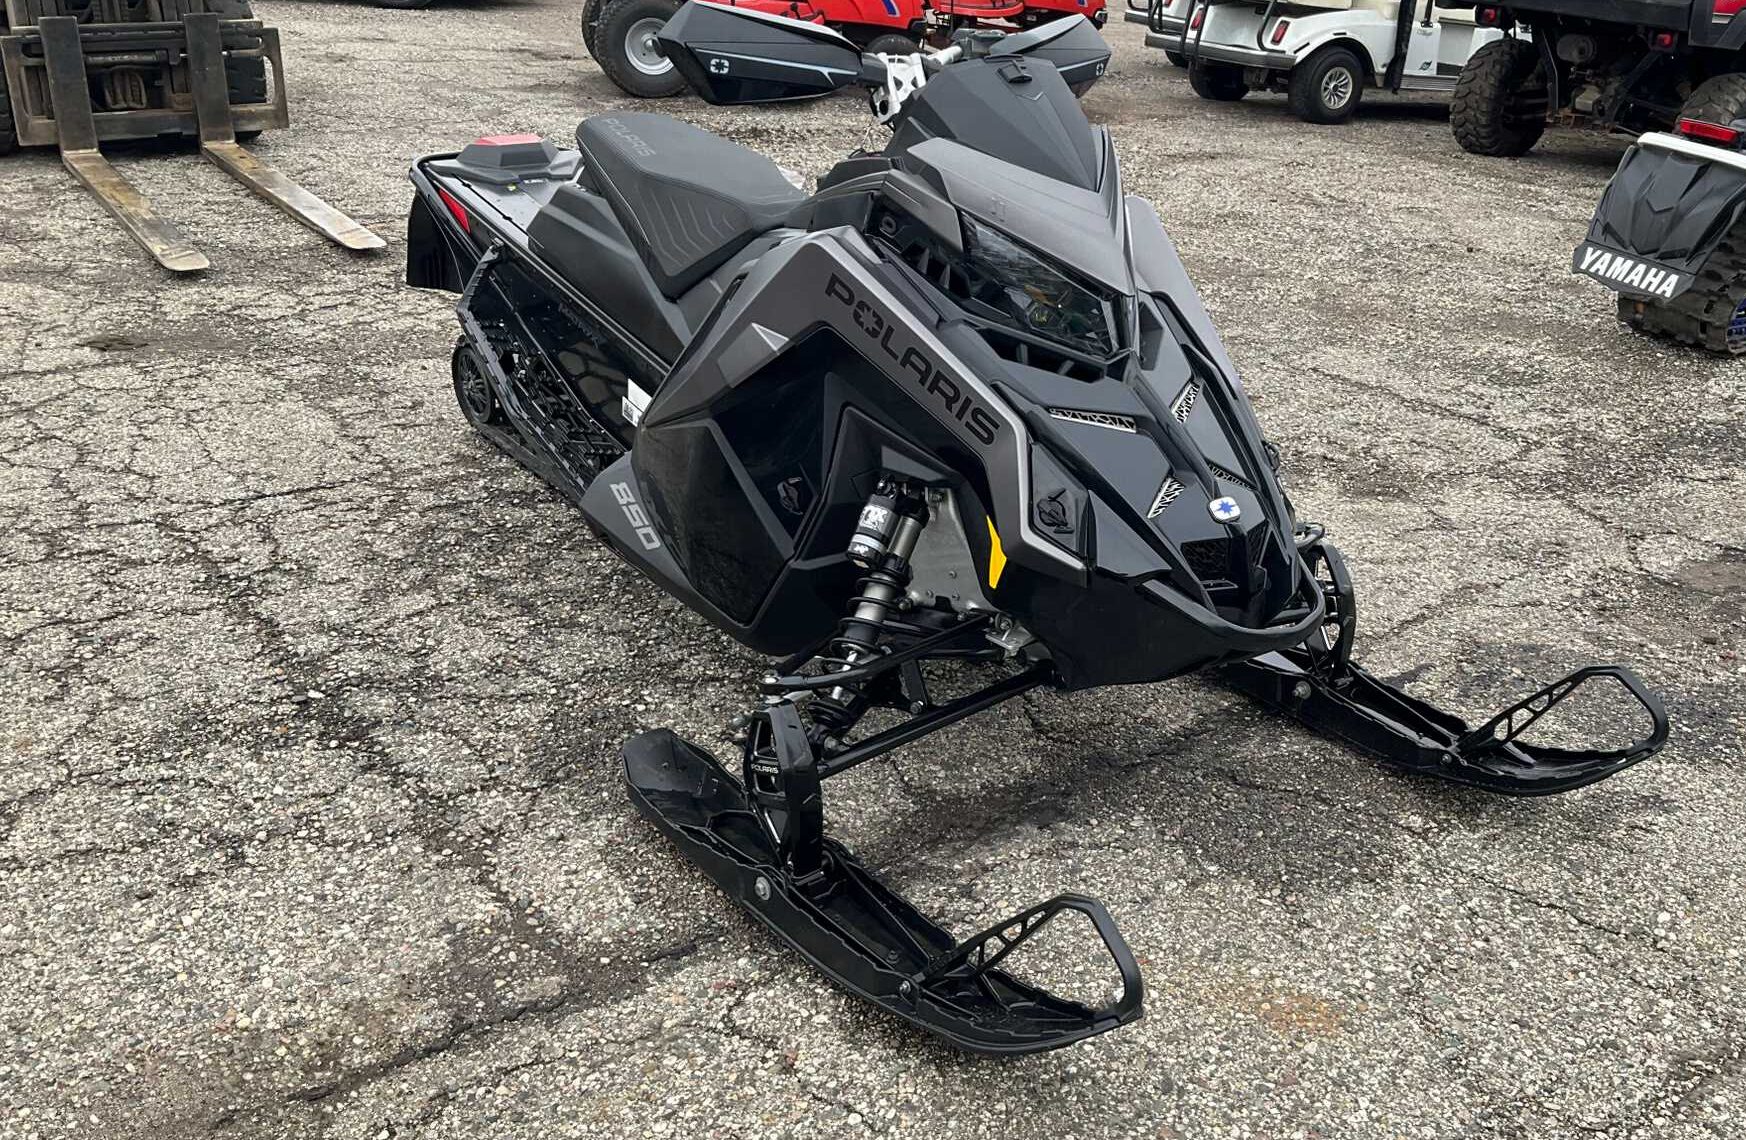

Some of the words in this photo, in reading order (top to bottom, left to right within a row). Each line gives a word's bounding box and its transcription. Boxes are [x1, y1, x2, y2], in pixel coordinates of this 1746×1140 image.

[1580, 246, 1680, 298] YAMAHA
[825, 272, 1001, 446] POLARIS
[609, 481, 661, 551] 850
[751, 763, 779, 774] POLARIS
